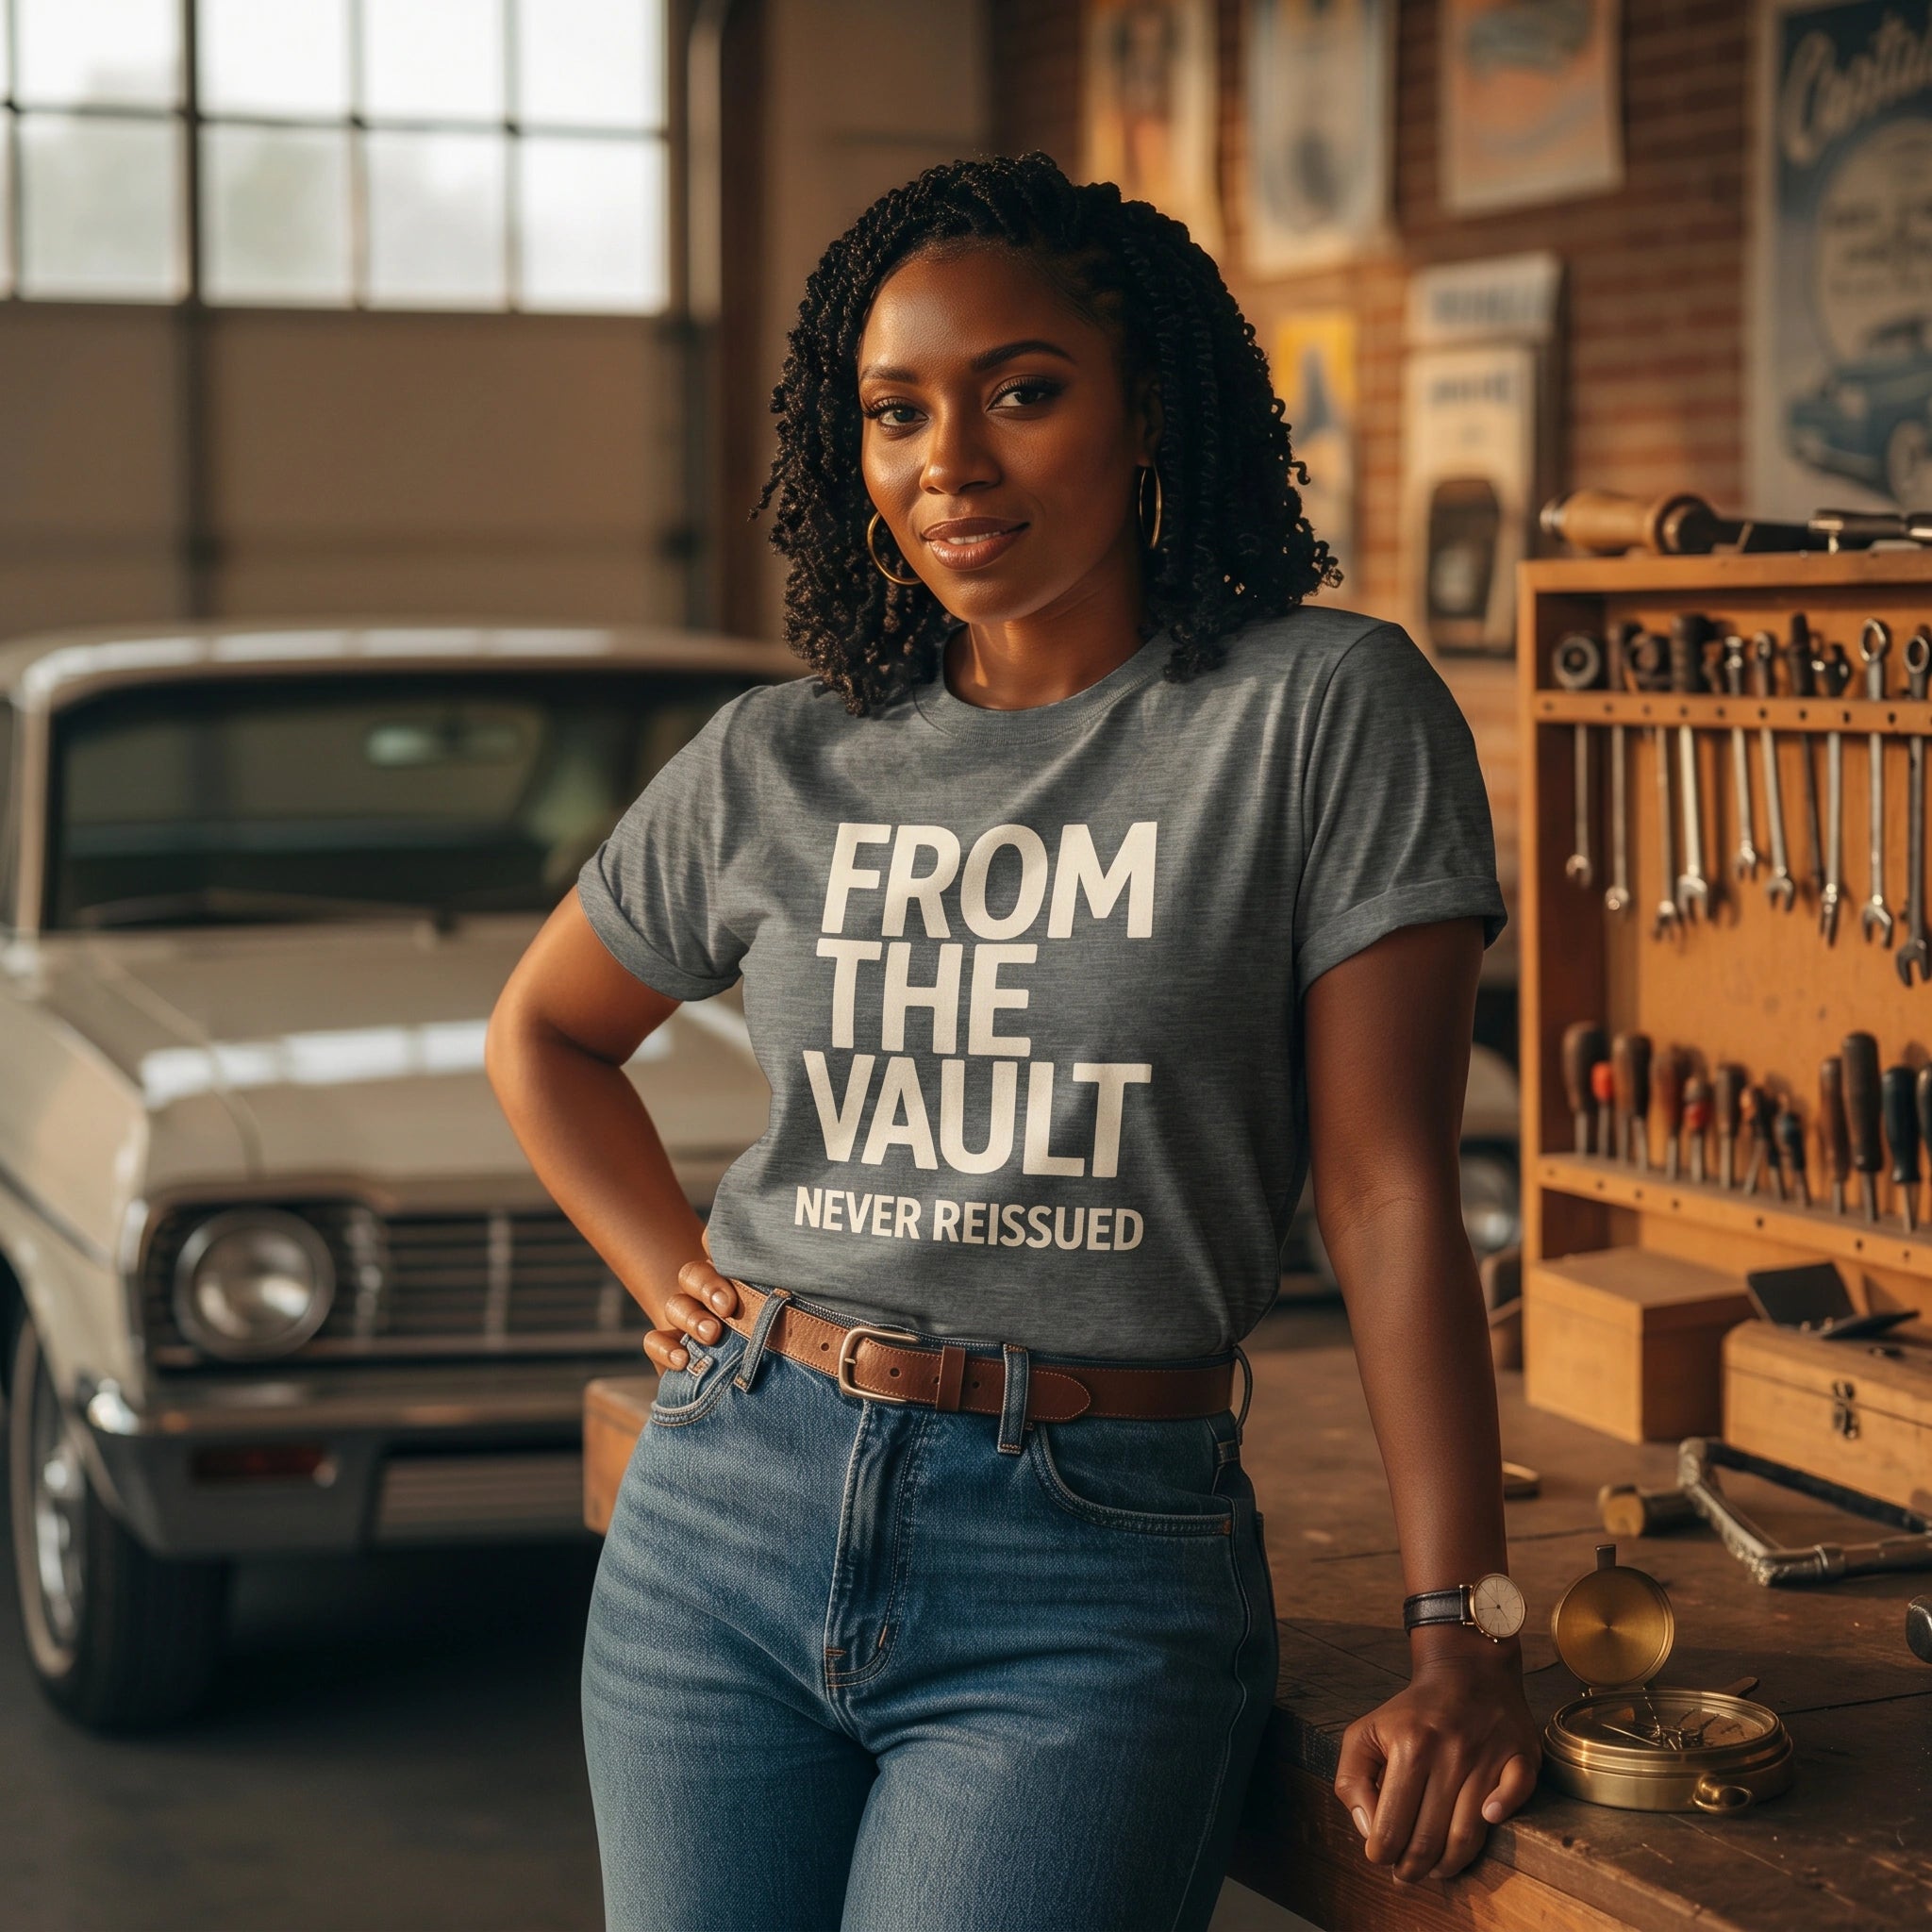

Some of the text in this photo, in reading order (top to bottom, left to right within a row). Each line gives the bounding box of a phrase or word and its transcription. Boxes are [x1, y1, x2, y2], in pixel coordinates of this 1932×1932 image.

[822, 822, 1158, 939] FROM
[816, 939, 1038, 1057] THE
[803, 1050, 1152, 1177] VAULT
[794, 1186, 1144, 1251] NEVER REISSUED
